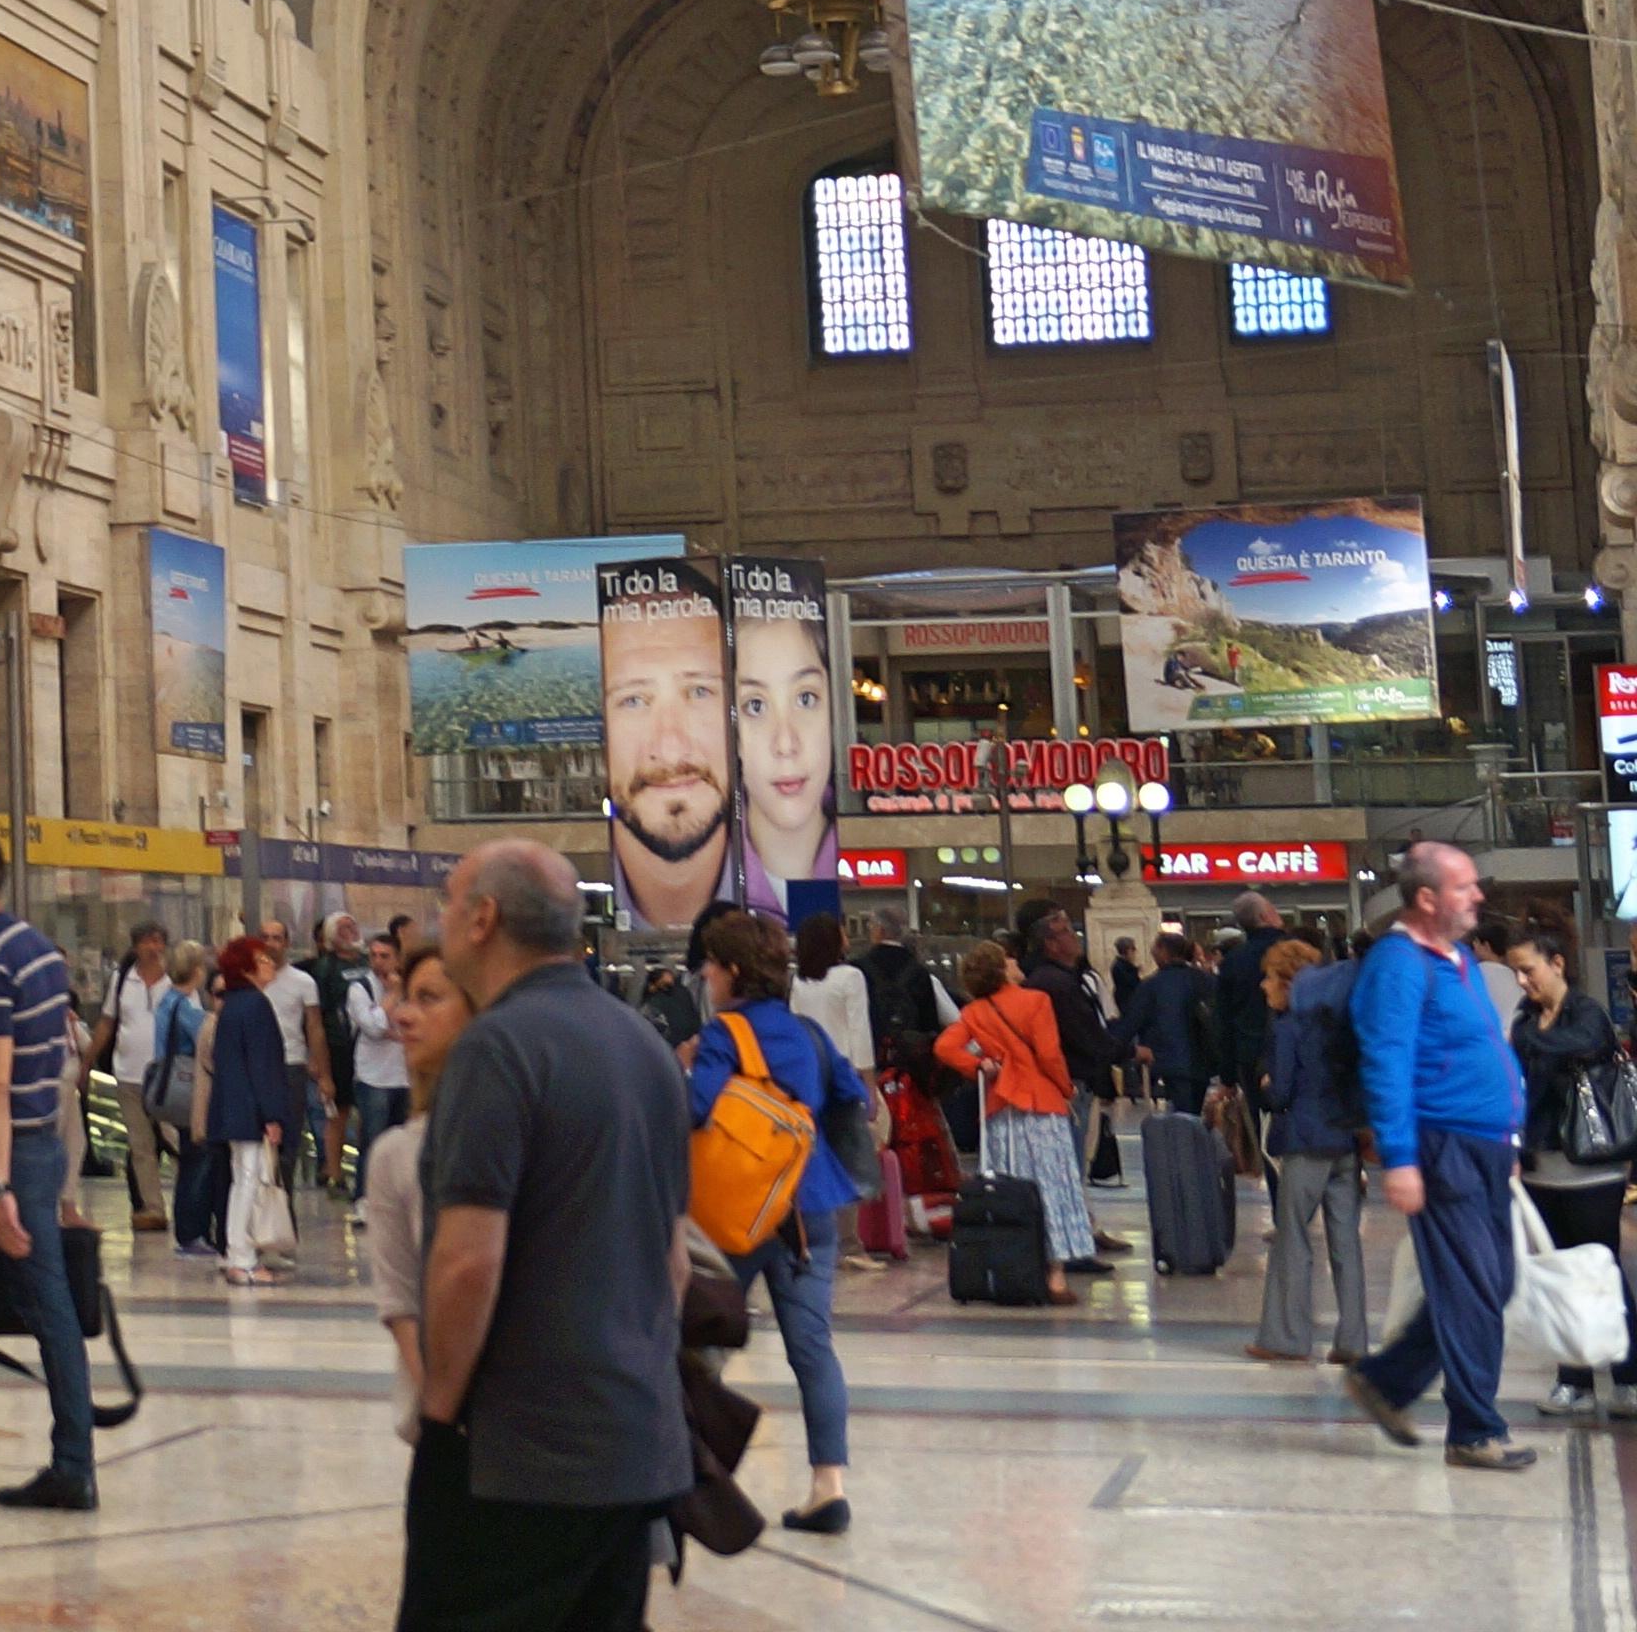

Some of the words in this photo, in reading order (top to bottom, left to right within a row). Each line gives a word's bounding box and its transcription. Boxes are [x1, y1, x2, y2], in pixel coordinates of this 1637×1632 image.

[1236, 555, 1297, 572] QUESTA
[1299, 549, 1311, 569] È
[600, 572, 621, 597] Ti
[625, 570, 654, 595] do
[658, 567, 678, 592] la
[747, 565, 771, 591] do
[775, 567, 792, 592] la
[603, 597, 641, 620] mia
[646, 592, 719, 625] parola.
[765, 594, 825, 623] parola.
[856, 859, 895, 877] BAR
[1159, 853, 1210, 875] BAR
[1237, 844, 1319, 874] CAFFÈ
